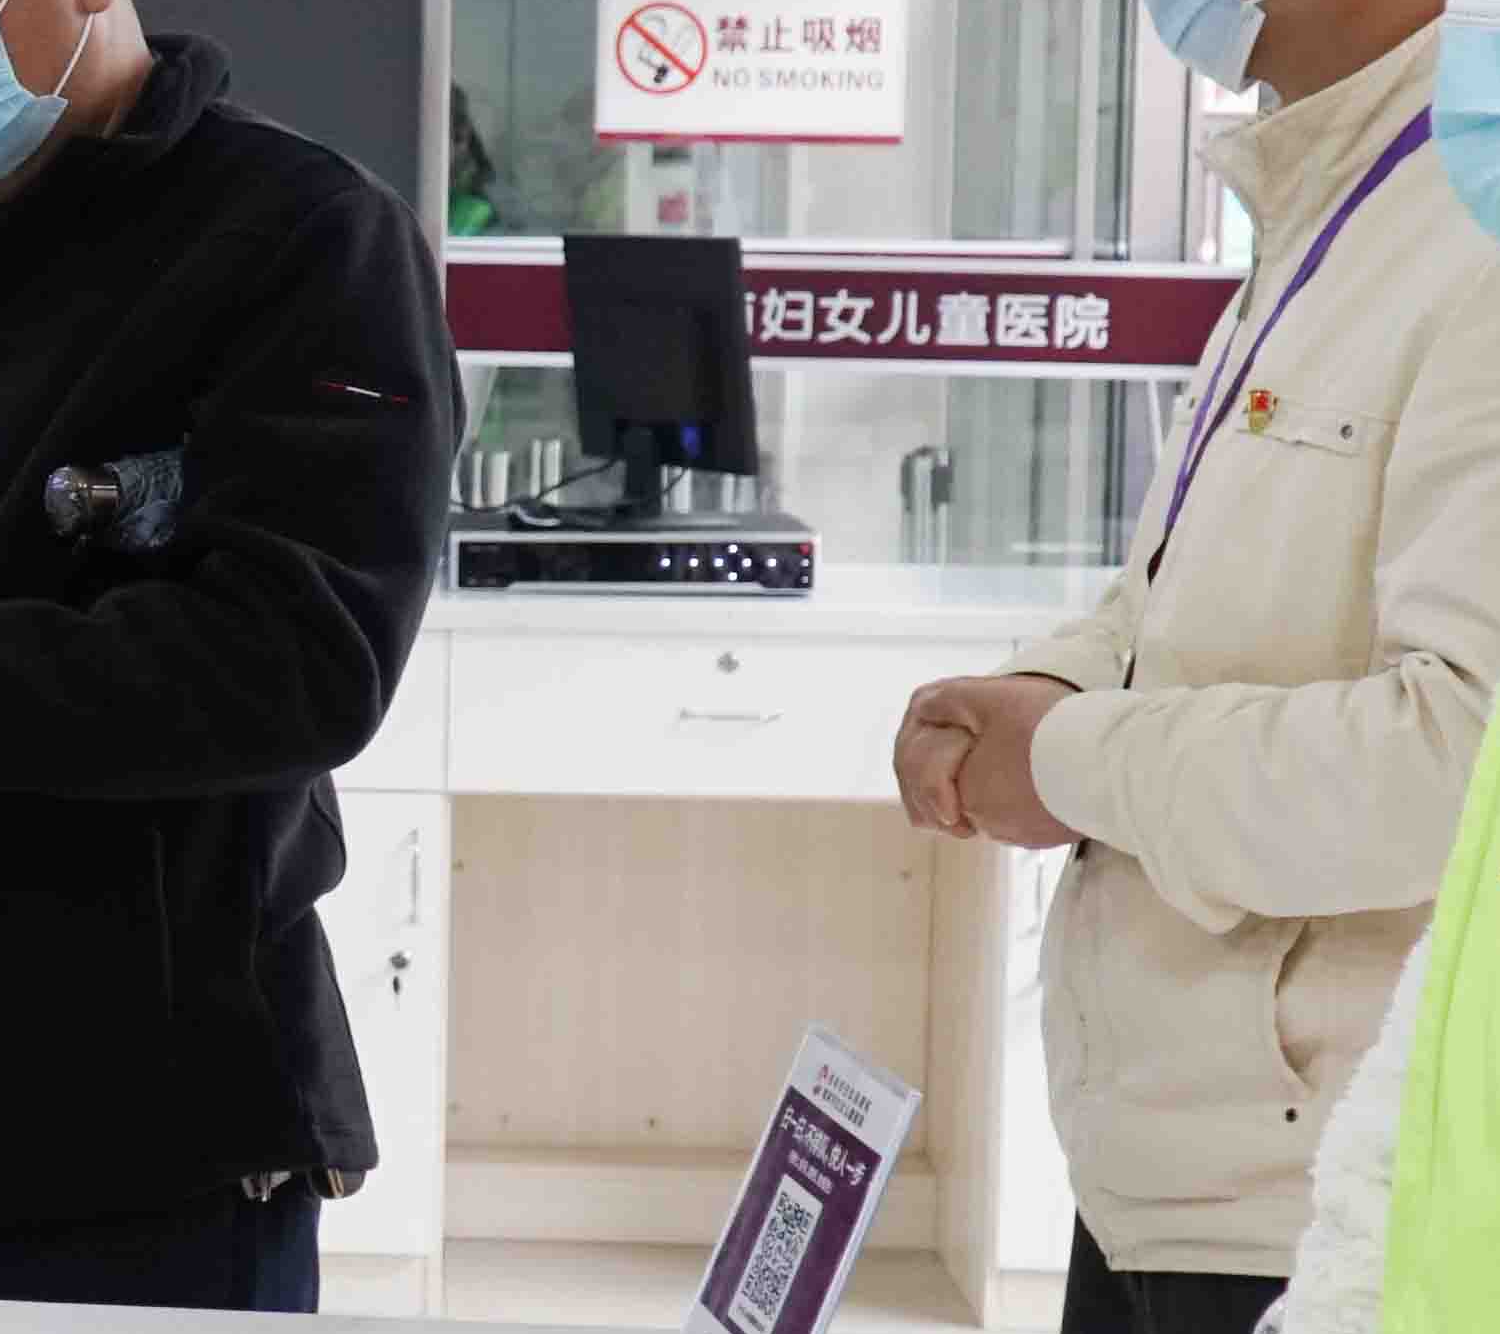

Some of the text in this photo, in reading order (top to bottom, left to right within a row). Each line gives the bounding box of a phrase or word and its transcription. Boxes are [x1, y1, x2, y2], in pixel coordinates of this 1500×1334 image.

[716, 15, 882, 54] 禁止吸烟
[713, 67, 884, 92] NO SMOKING
